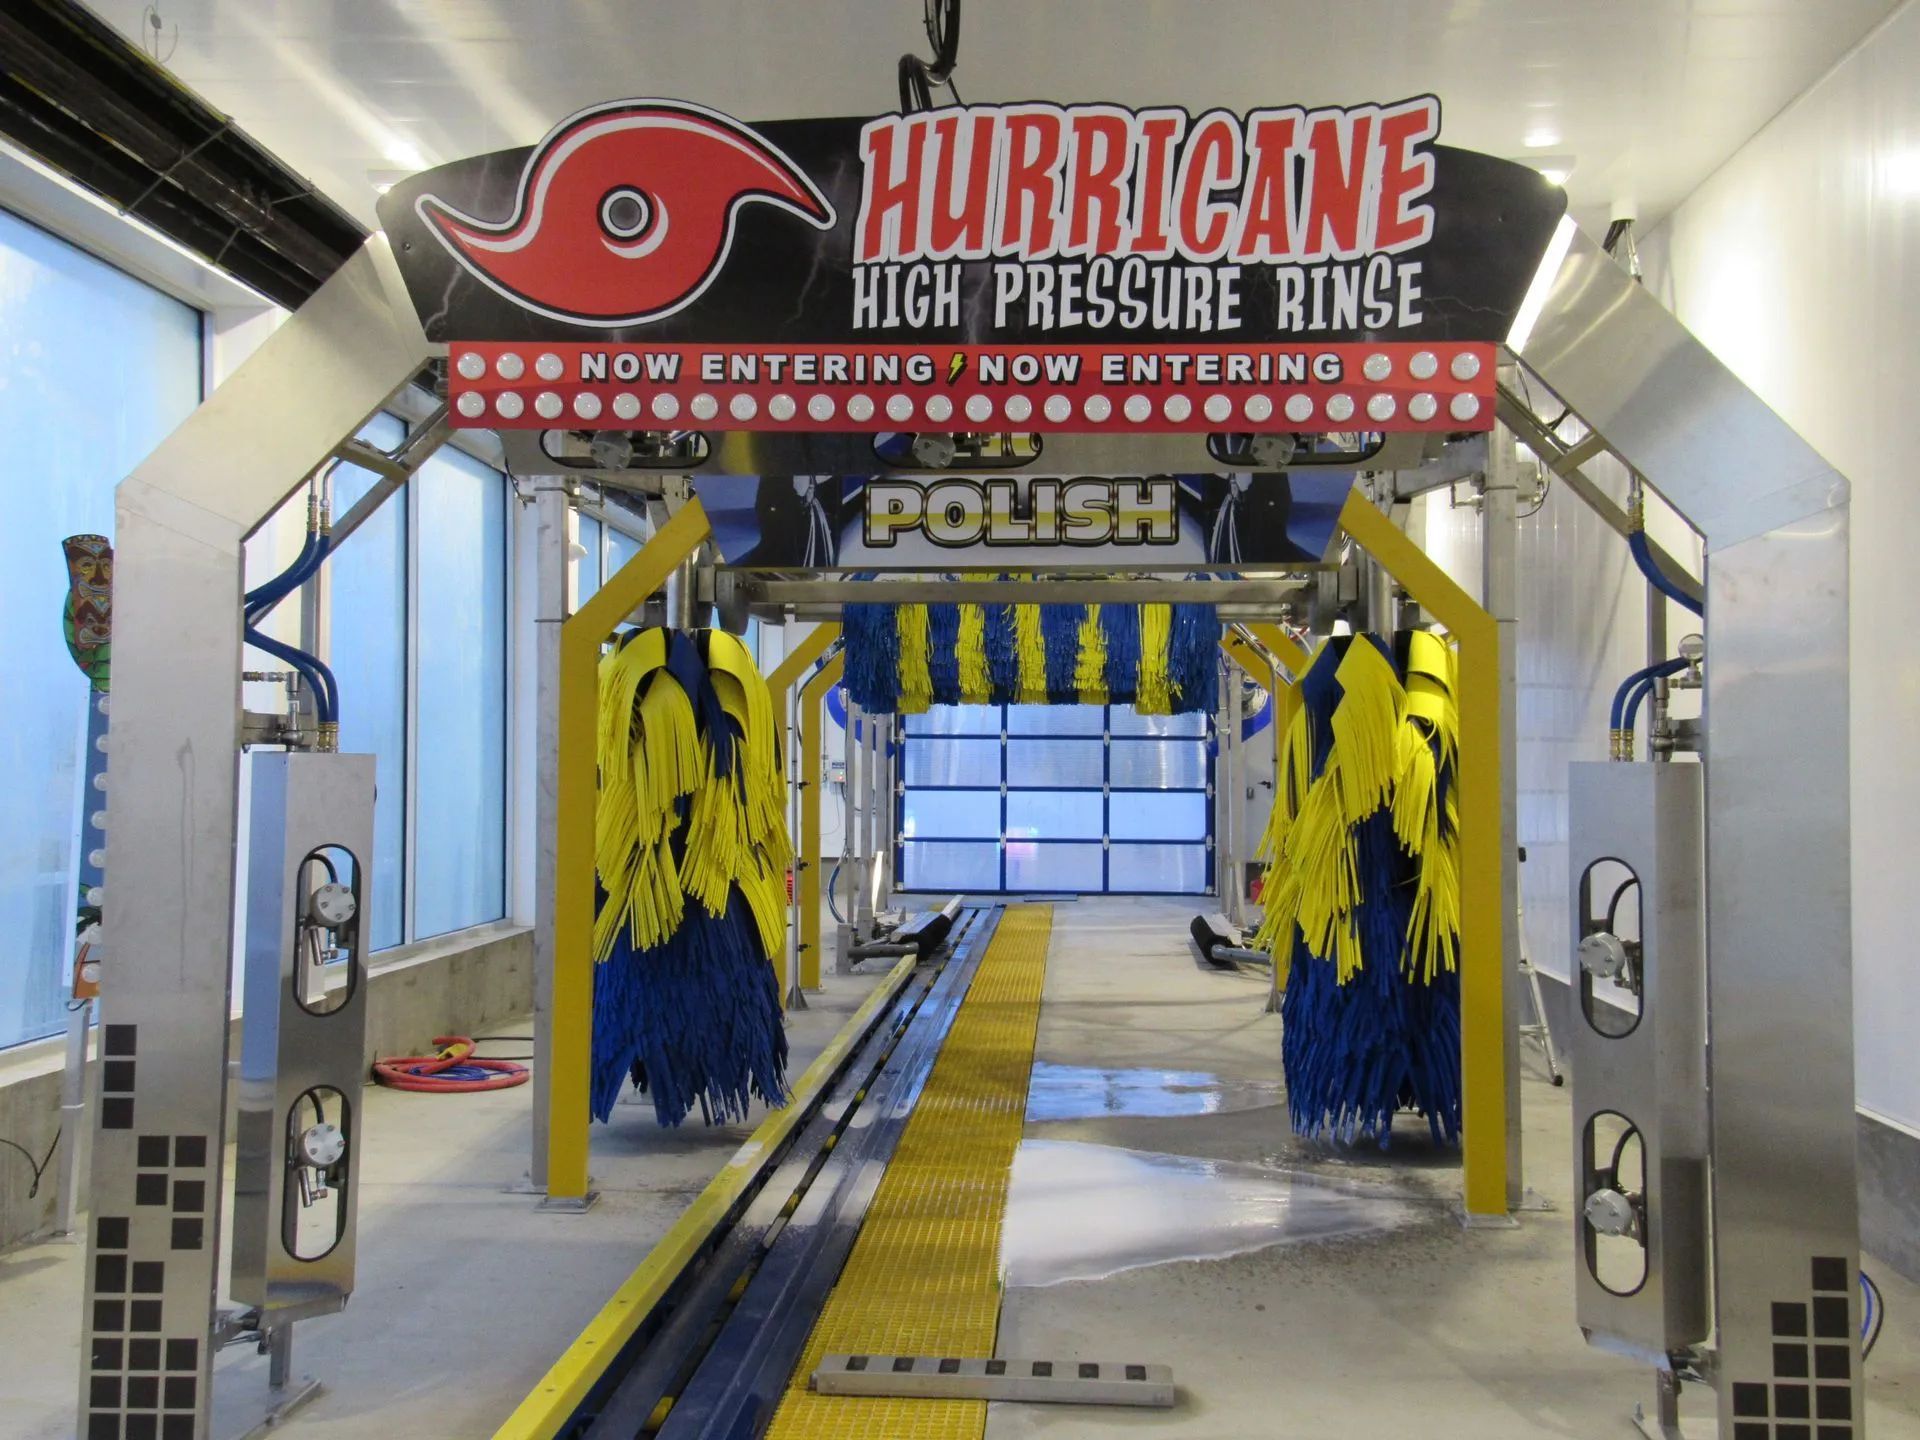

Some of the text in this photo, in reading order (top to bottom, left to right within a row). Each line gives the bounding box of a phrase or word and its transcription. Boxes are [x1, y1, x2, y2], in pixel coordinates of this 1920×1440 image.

[855, 96, 1440, 265] HURRICANE
[852, 254, 1423, 332] HIGH PRESSURE RINSE
[579, 353, 1343, 384] NOW ENTERING NOW ENTERING
[864, 479, 1179, 548] POLISH
